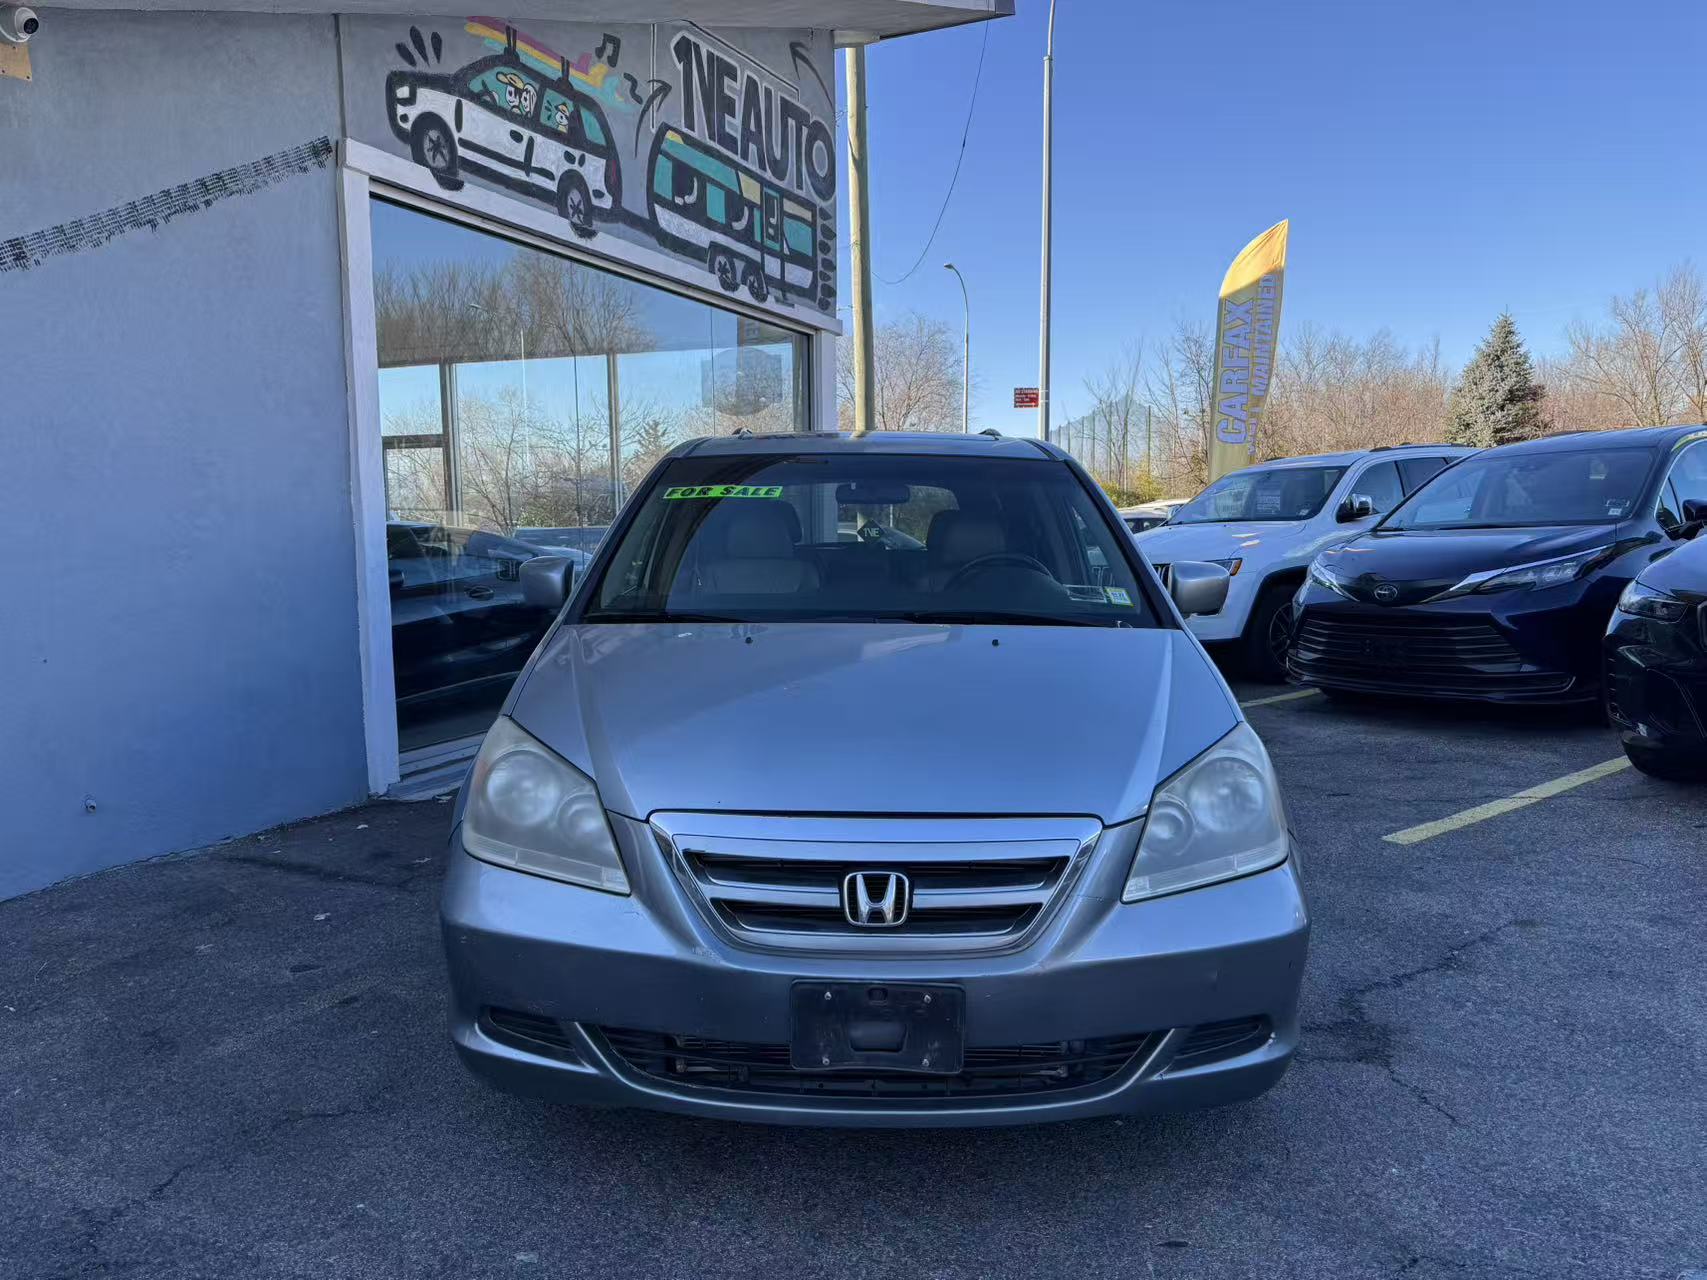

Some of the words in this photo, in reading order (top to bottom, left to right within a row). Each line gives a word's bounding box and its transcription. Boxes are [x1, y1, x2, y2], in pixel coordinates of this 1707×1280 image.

[1216, 297, 1254, 445] CARFAX
[665, 486, 714, 497] FOR
[719, 486, 781, 496] SALE
